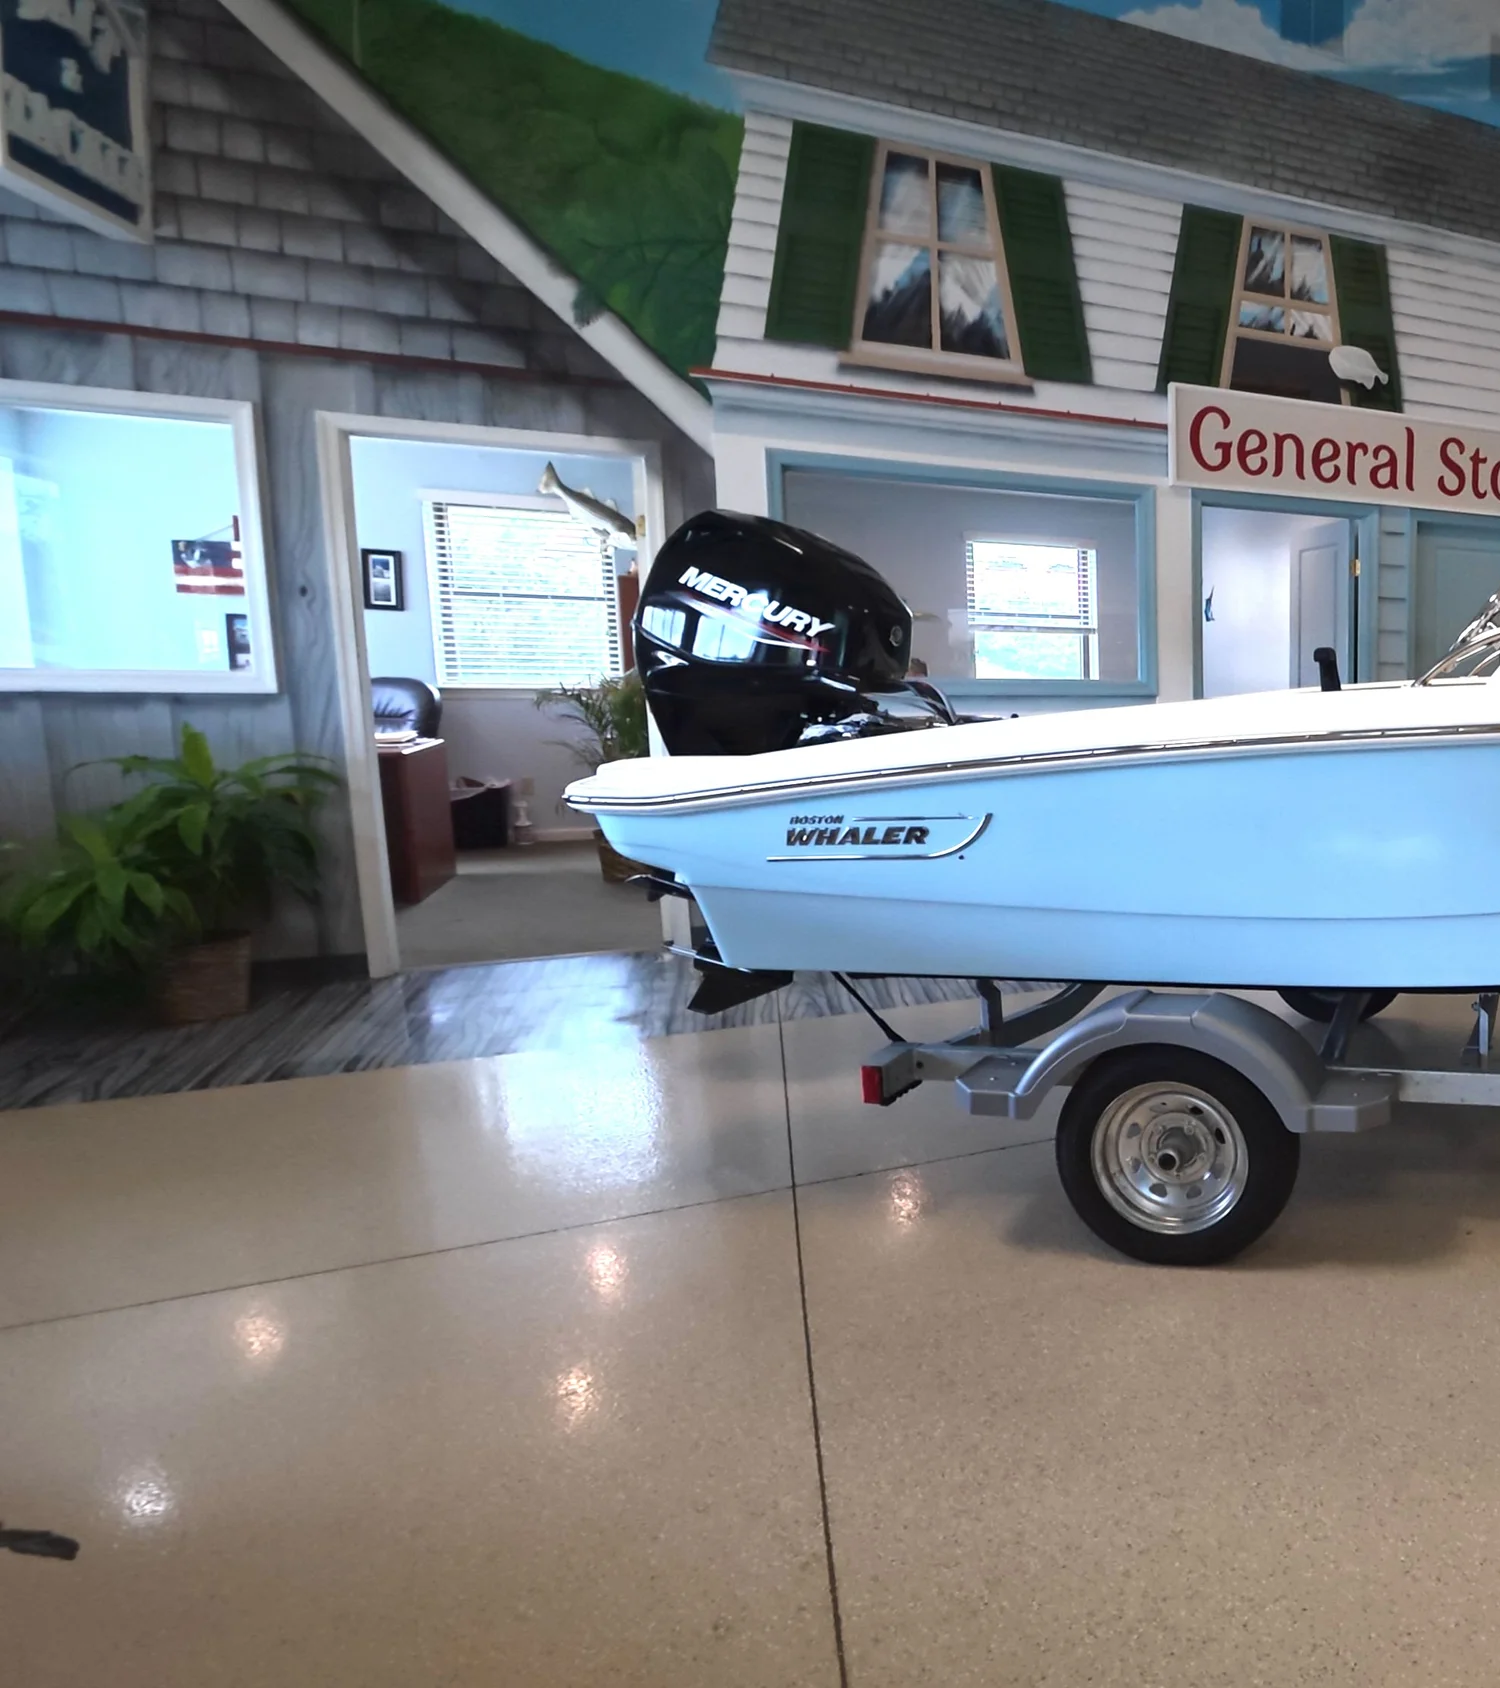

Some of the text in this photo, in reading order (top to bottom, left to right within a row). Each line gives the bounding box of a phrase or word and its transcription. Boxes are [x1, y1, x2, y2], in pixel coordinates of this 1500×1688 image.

[1189, 405, 1415, 491] General
[678, 566, 835, 637] MERCURY
[786, 826, 930, 846] WHALER
[789, 815, 844, 825] BOSTON
